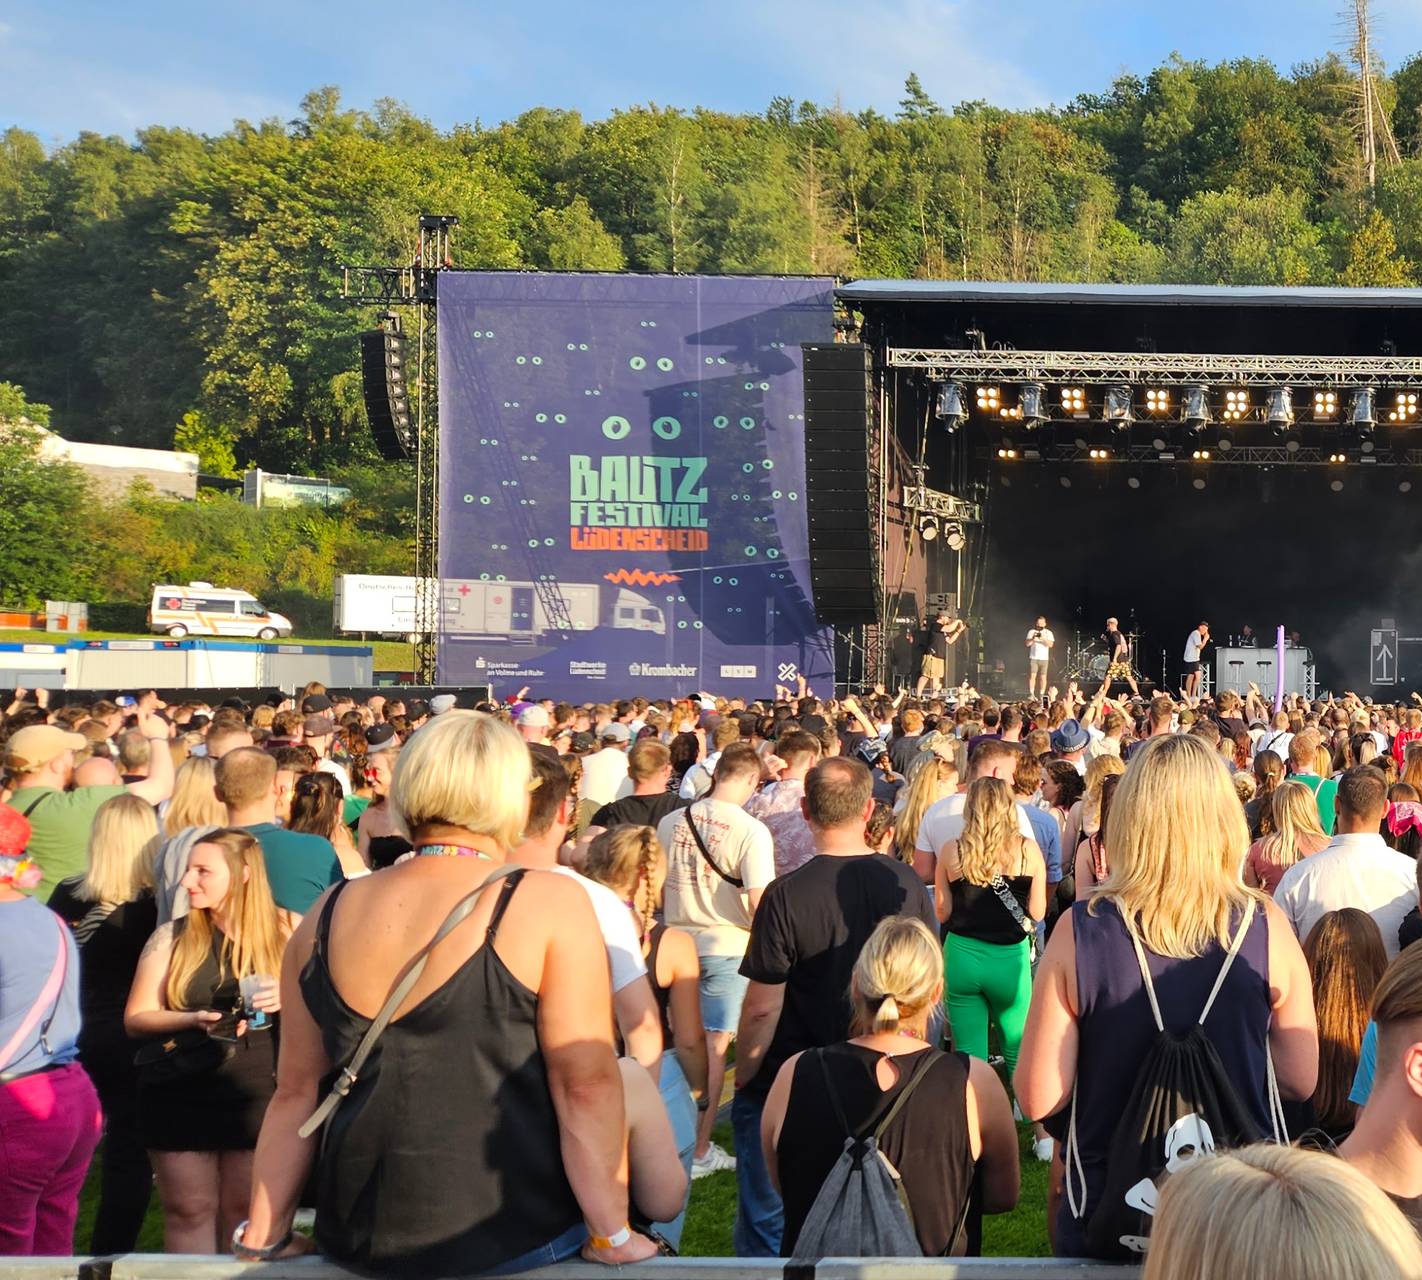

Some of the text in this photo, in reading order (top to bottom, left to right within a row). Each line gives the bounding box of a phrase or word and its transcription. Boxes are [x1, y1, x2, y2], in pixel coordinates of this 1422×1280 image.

[569, 454, 708, 503] BAUTZ
[570, 502, 708, 527] FESTIVAL
[487, 662, 519, 670] Sparkasse
[641, 663, 698, 676] Krombacher
